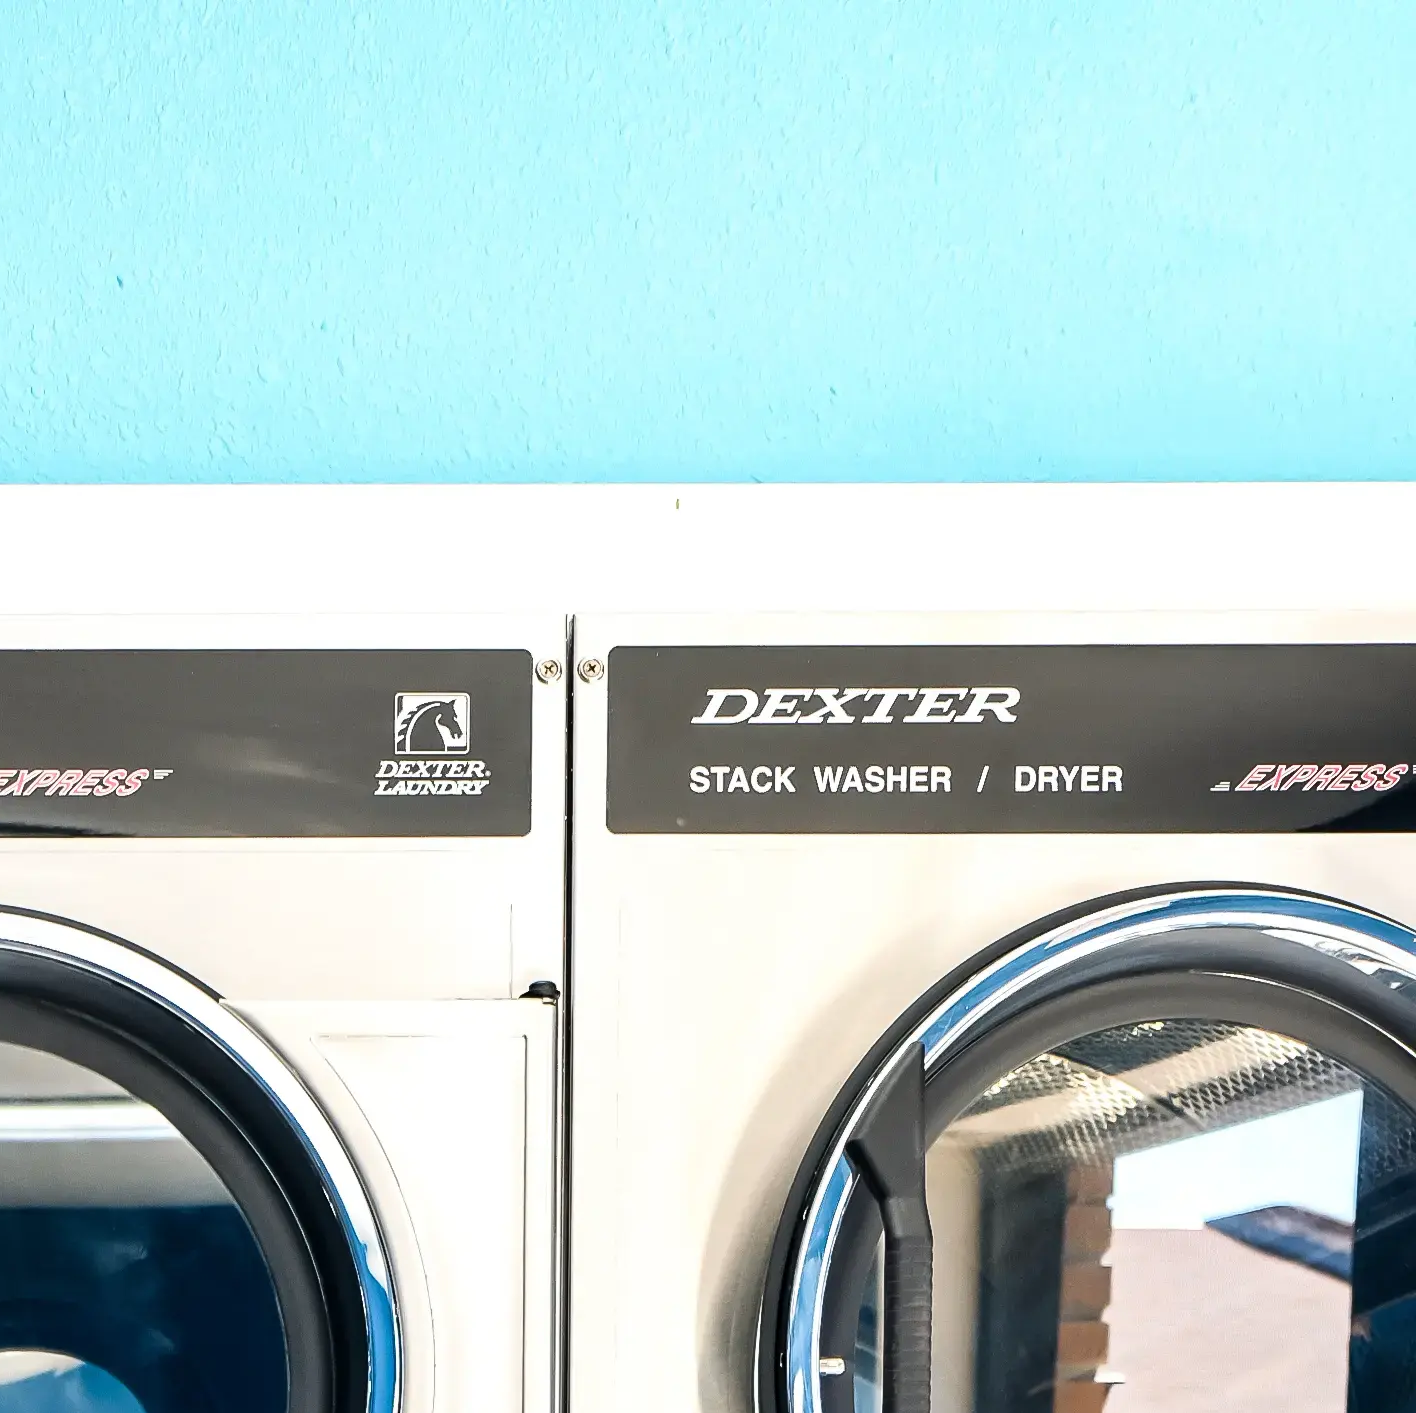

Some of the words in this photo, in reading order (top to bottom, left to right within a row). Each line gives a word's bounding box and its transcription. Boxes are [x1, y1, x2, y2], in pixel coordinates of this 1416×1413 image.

[691, 687, 1021, 724] DEXTER
[374, 760, 486, 778] DEXTER
[690, 766, 796, 792] STACK
[814, 766, 952, 792] WASHER
[1015, 766, 1123, 792] DRYER
[1235, 764, 1410, 791] EXPRESS
[374, 780, 489, 795] LAUNDRY
